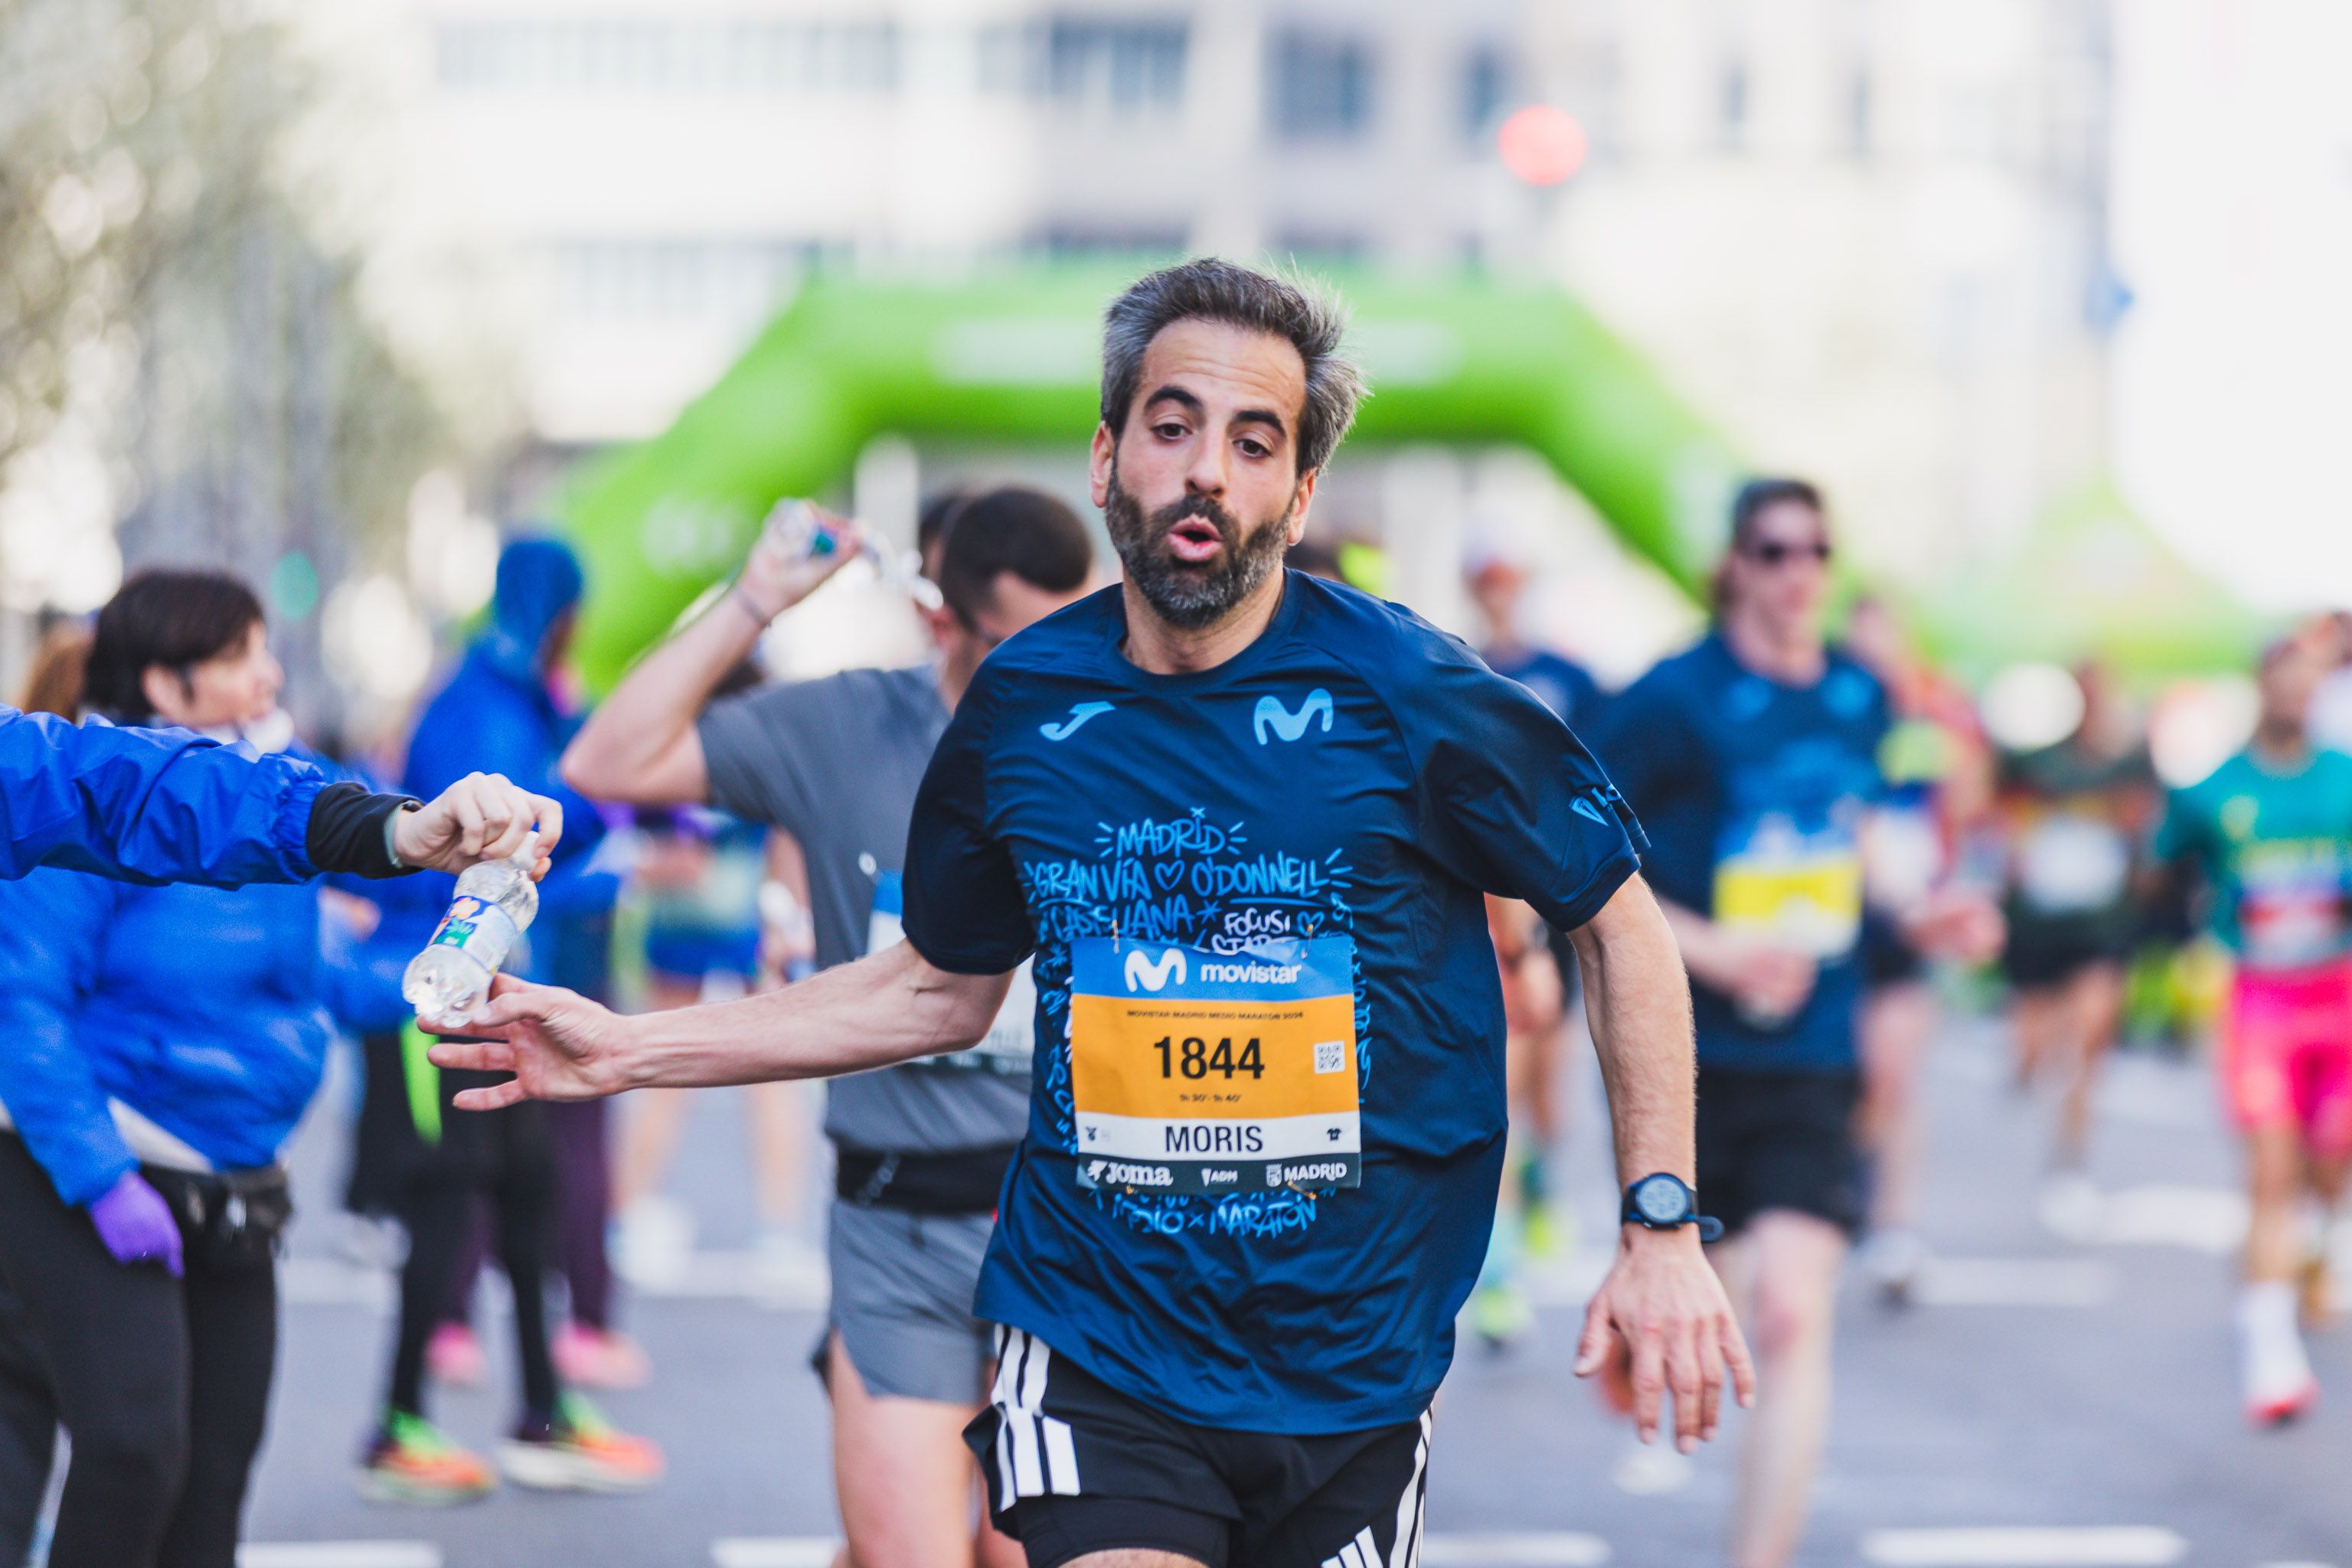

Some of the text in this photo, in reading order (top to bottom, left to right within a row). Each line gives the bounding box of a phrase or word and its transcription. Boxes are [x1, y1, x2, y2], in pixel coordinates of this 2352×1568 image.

[1117, 808, 1225, 858] MADRID
[1191, 850, 1331, 898] O'DONNELL
[1200, 960, 1303, 984] movistar
[1127, 1009, 1169, 1018] MOVISTAR
[1172, 1011, 1207, 1020] MADRID
[1209, 1011, 1236, 1020] MEDIO
[1154, 1036, 1265, 1080] 1844
[1165, 1125, 1264, 1153] MORIS
[1283, 1162, 1348, 1182] MADRID
